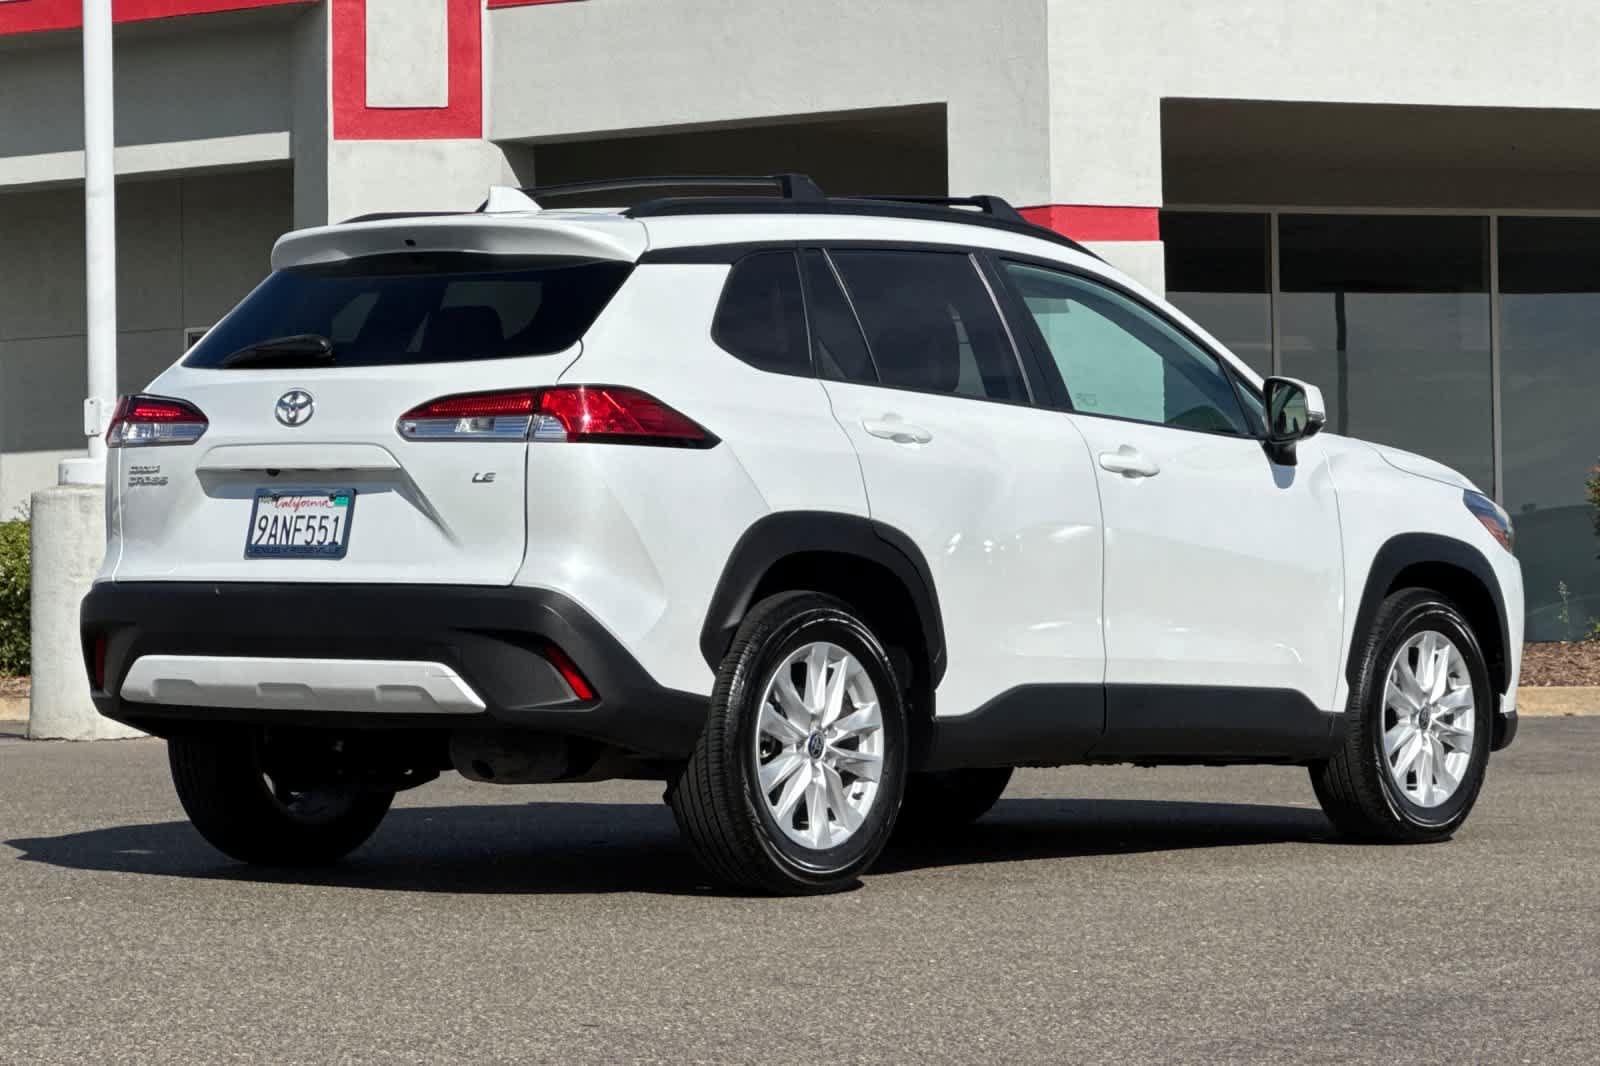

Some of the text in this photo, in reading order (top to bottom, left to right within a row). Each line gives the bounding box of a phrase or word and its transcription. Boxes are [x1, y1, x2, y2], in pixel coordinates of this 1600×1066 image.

[472, 472, 496, 483] LE
[274, 495, 332, 512] California
[254, 514, 340, 545] 9ANF551
